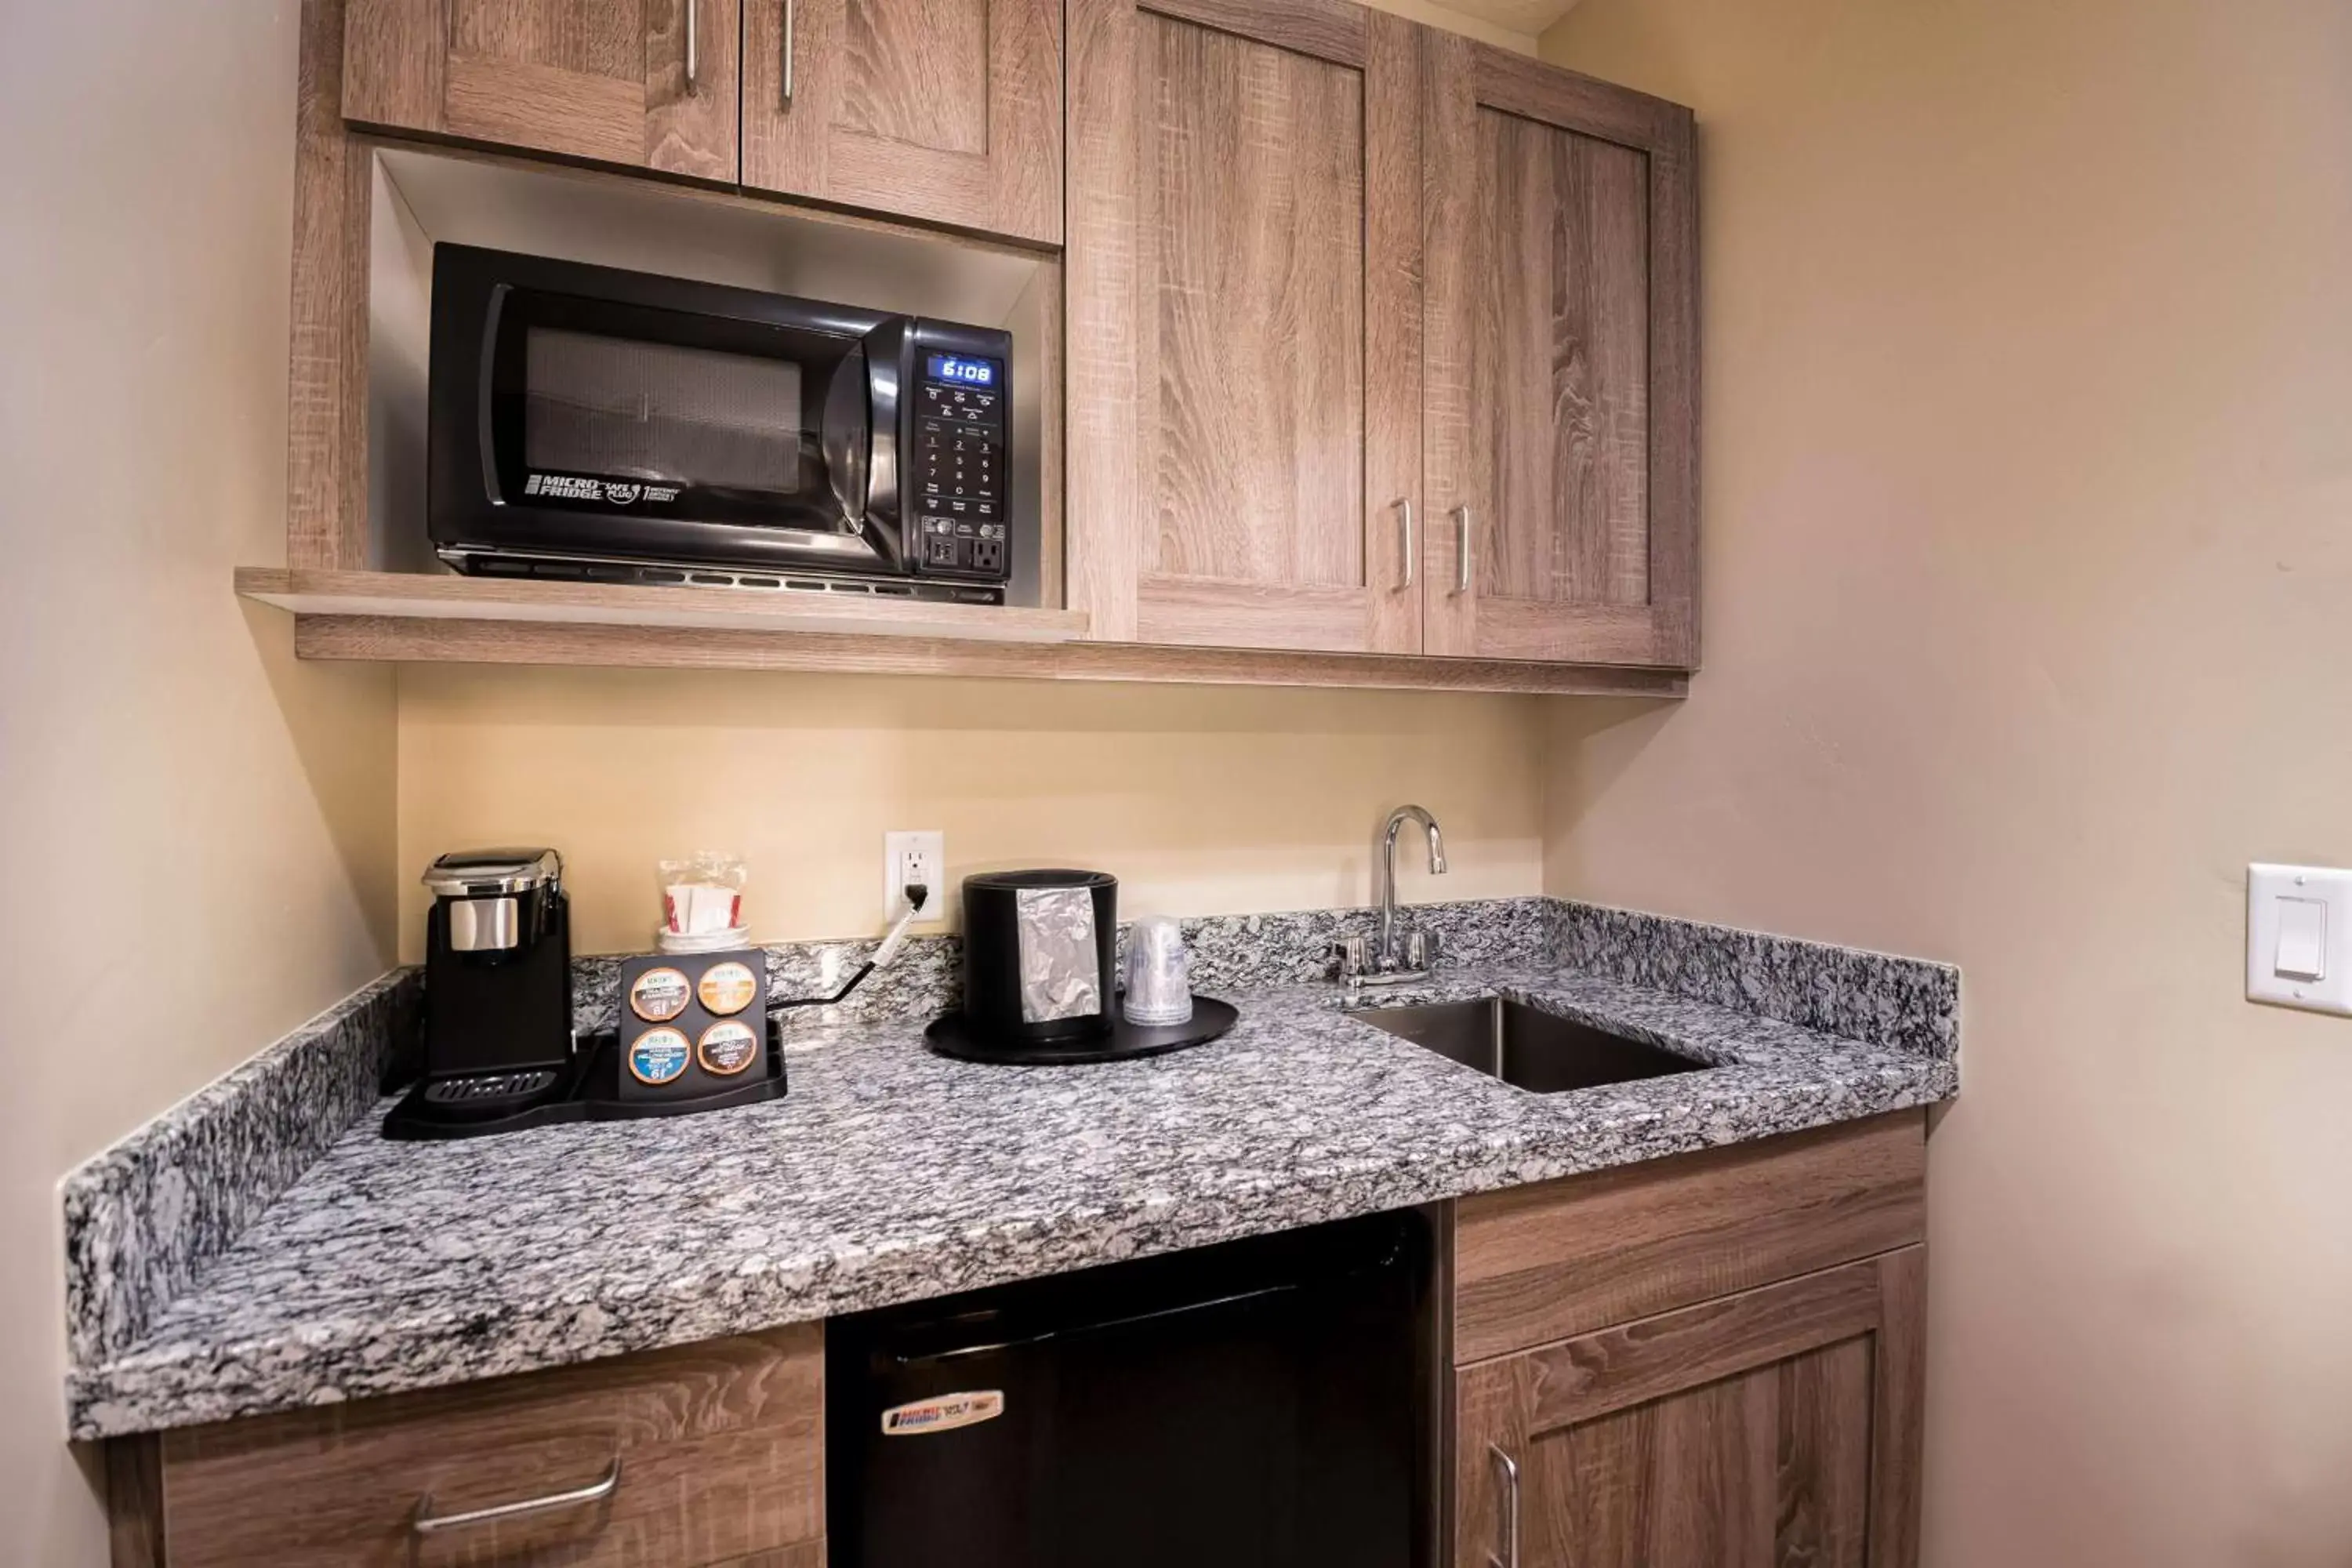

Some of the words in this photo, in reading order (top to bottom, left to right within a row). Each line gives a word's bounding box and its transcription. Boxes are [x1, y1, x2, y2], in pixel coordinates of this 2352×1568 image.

[942, 361, 991, 381] 6:08
[543, 475, 599, 489] MICRO
[539, 485, 603, 500] FRIDGE
[956, 486, 964, 495] 0
